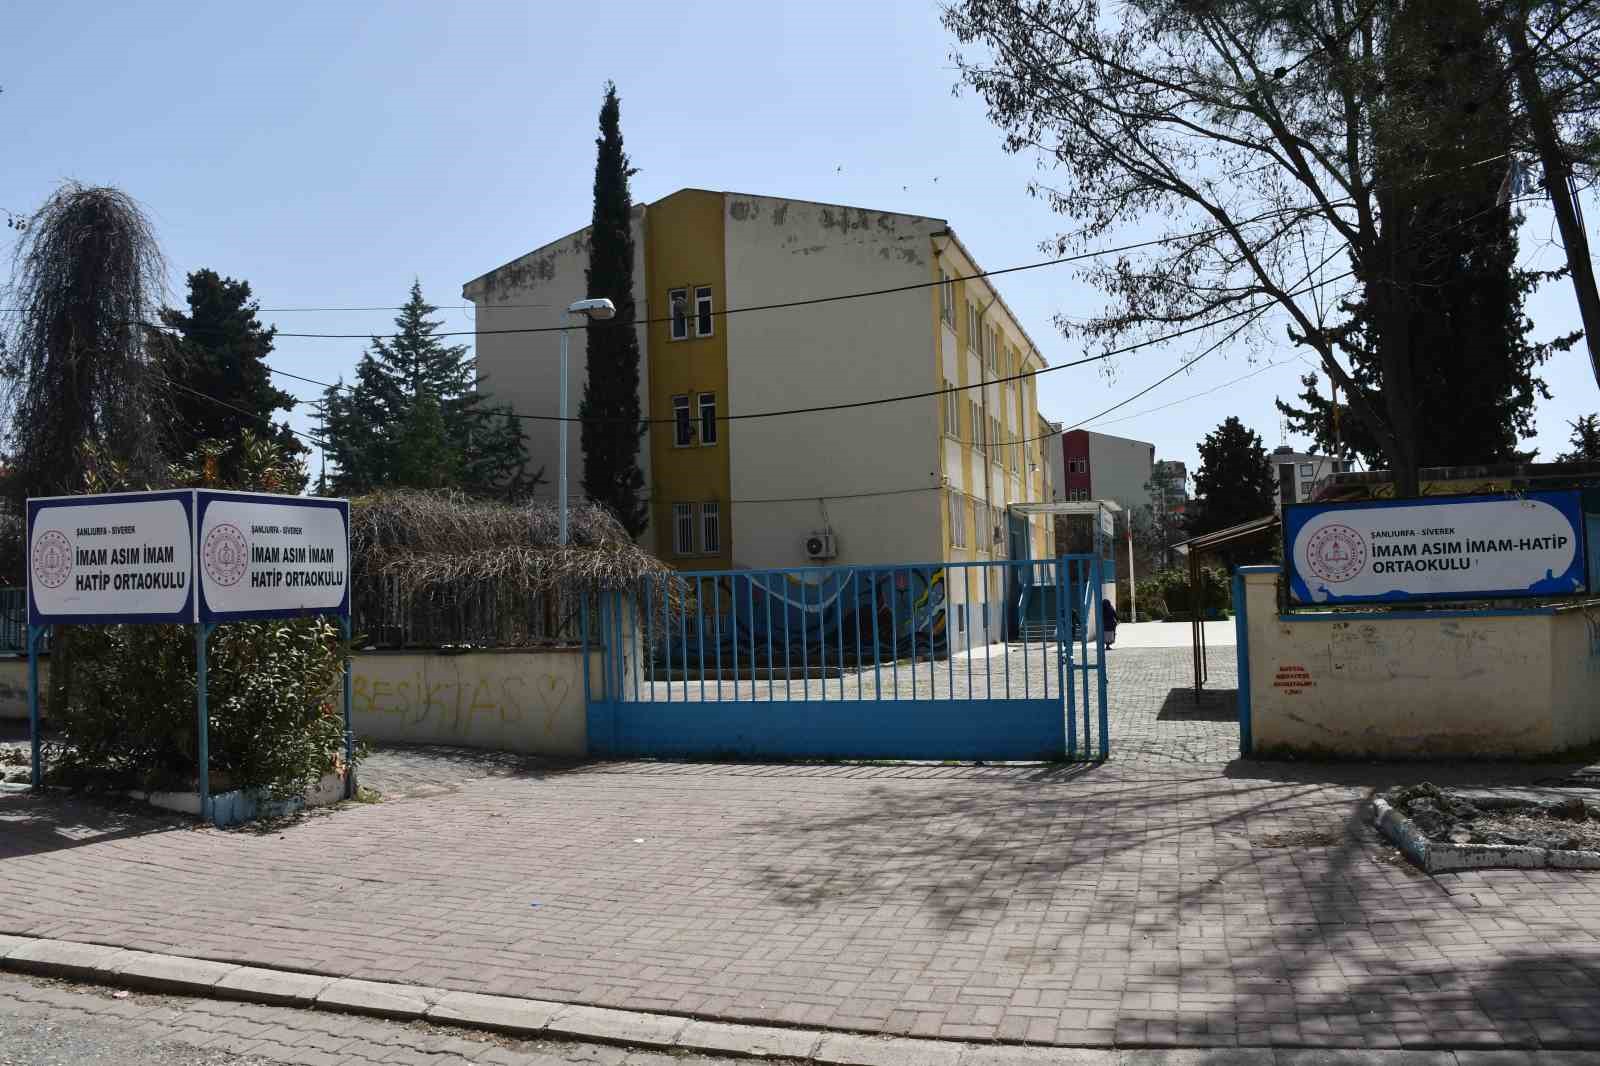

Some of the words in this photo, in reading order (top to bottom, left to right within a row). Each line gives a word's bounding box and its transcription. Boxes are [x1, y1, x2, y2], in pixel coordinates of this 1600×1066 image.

[76, 527, 107, 539] ŞANLIURFA
[1371, 530, 1416, 539] ŞANLIURFA
[1422, 527, 1456, 536] SİVEREK
[76, 546, 107, 566] İMAM
[111, 547, 140, 564] ASIM
[144, 544, 174, 563] İMAM
[252, 543, 280, 563] İMAM
[283, 547, 306, 563] ASIM
[309, 545, 334, 563] İMAM
[1372, 543, 1417, 558] İMAM
[1422, 541, 1462, 556] ASIM
[1466, 534, 1568, 553] İMAM-HATİP
[1372, 557, 1471, 574] ORTAOKULU
[76, 570, 110, 591] HATİP
[113, 572, 185, 590] ORTAOKULU
[252, 568, 282, 588] HATİP
[286, 571, 343, 587] ORTAOKULU
